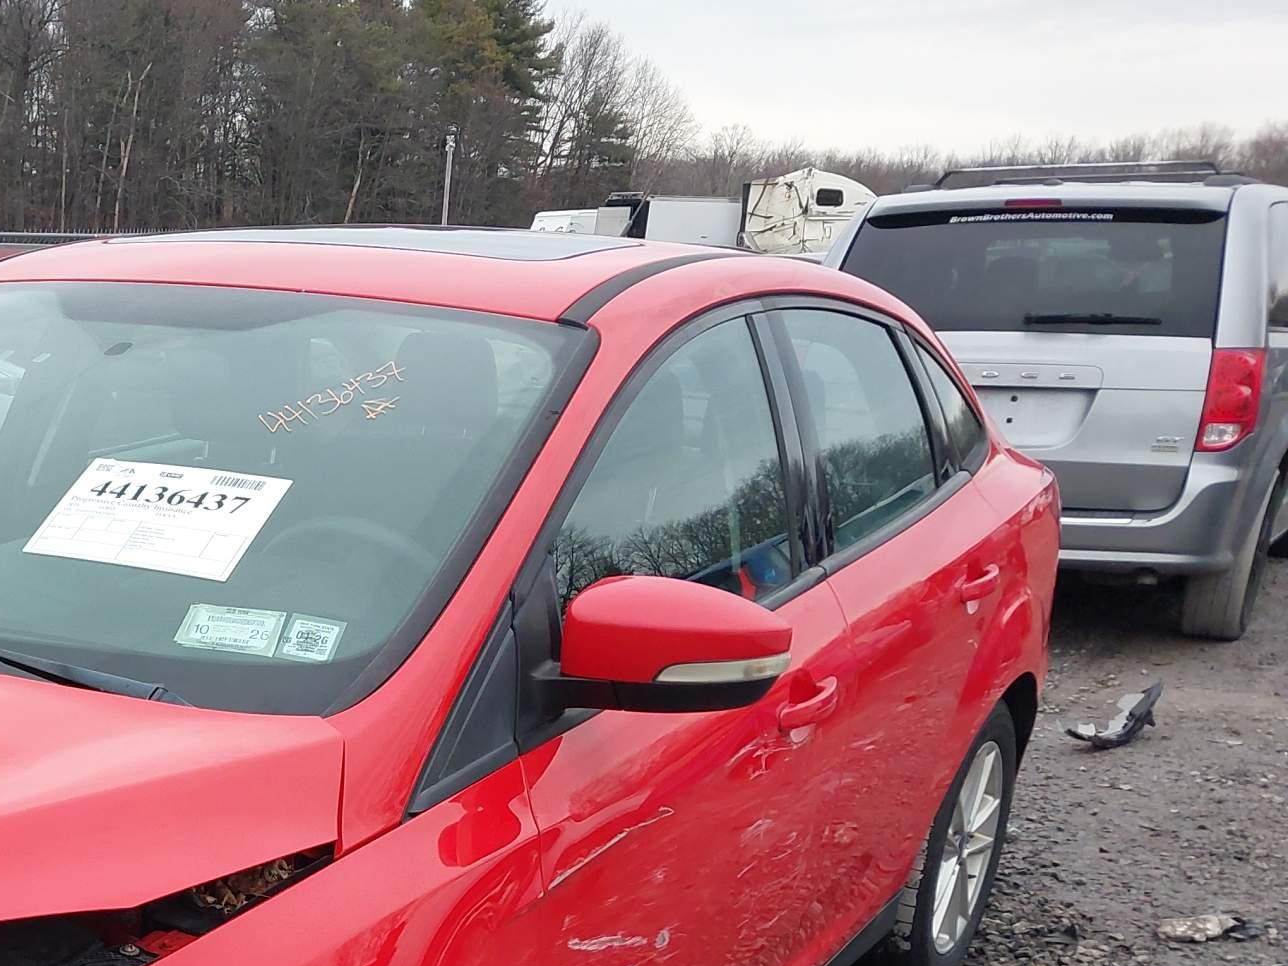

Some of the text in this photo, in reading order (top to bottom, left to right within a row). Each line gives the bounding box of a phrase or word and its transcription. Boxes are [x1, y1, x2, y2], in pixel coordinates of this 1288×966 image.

[949, 211, 1114, 223] BrownBrothersAutomotive.com
[90, 480, 252, 514] 44136437
[194, 623, 210, 635] 10
